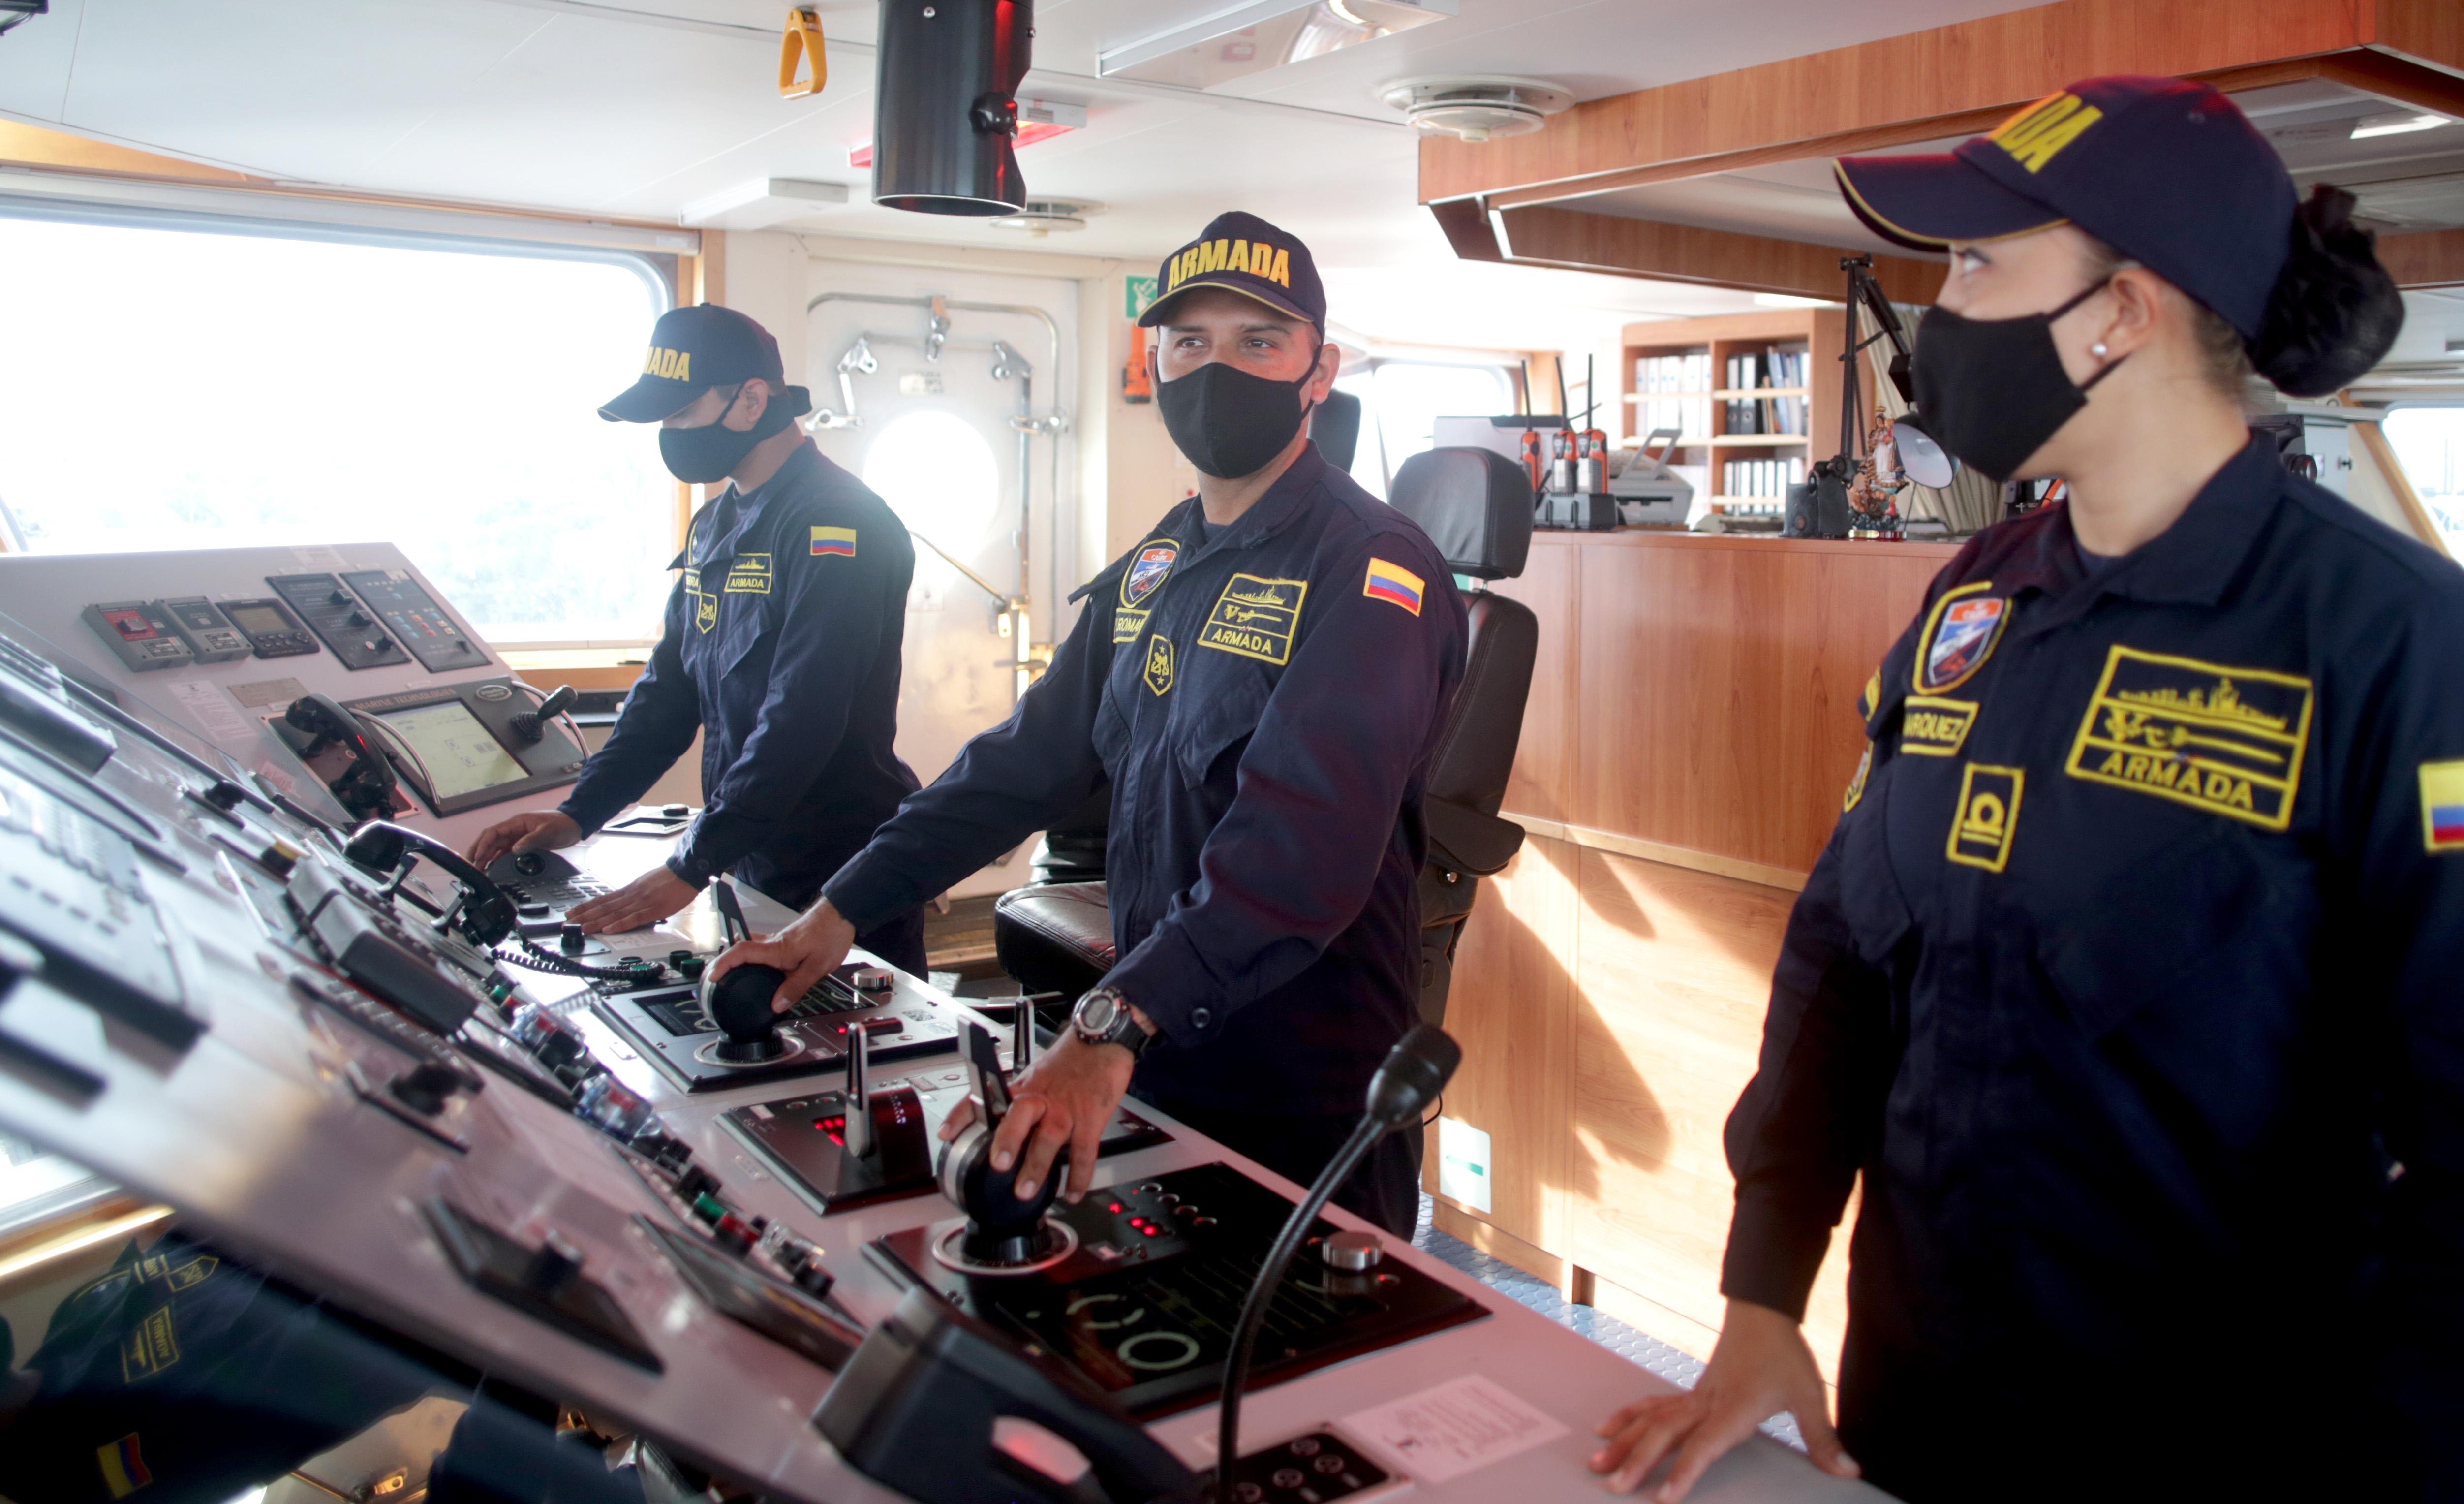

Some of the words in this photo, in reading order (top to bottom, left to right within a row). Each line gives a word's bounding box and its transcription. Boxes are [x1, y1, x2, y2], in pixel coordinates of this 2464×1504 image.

[1167, 239, 1289, 292] ARMADA
[643, 346, 691, 382] ADA
[730, 578, 764, 588] ARMADA
[1211, 628, 1272, 655] ARMADA
[355, 698, 393, 710] MARINE
[2099, 751, 2254, 810] ARMADA
